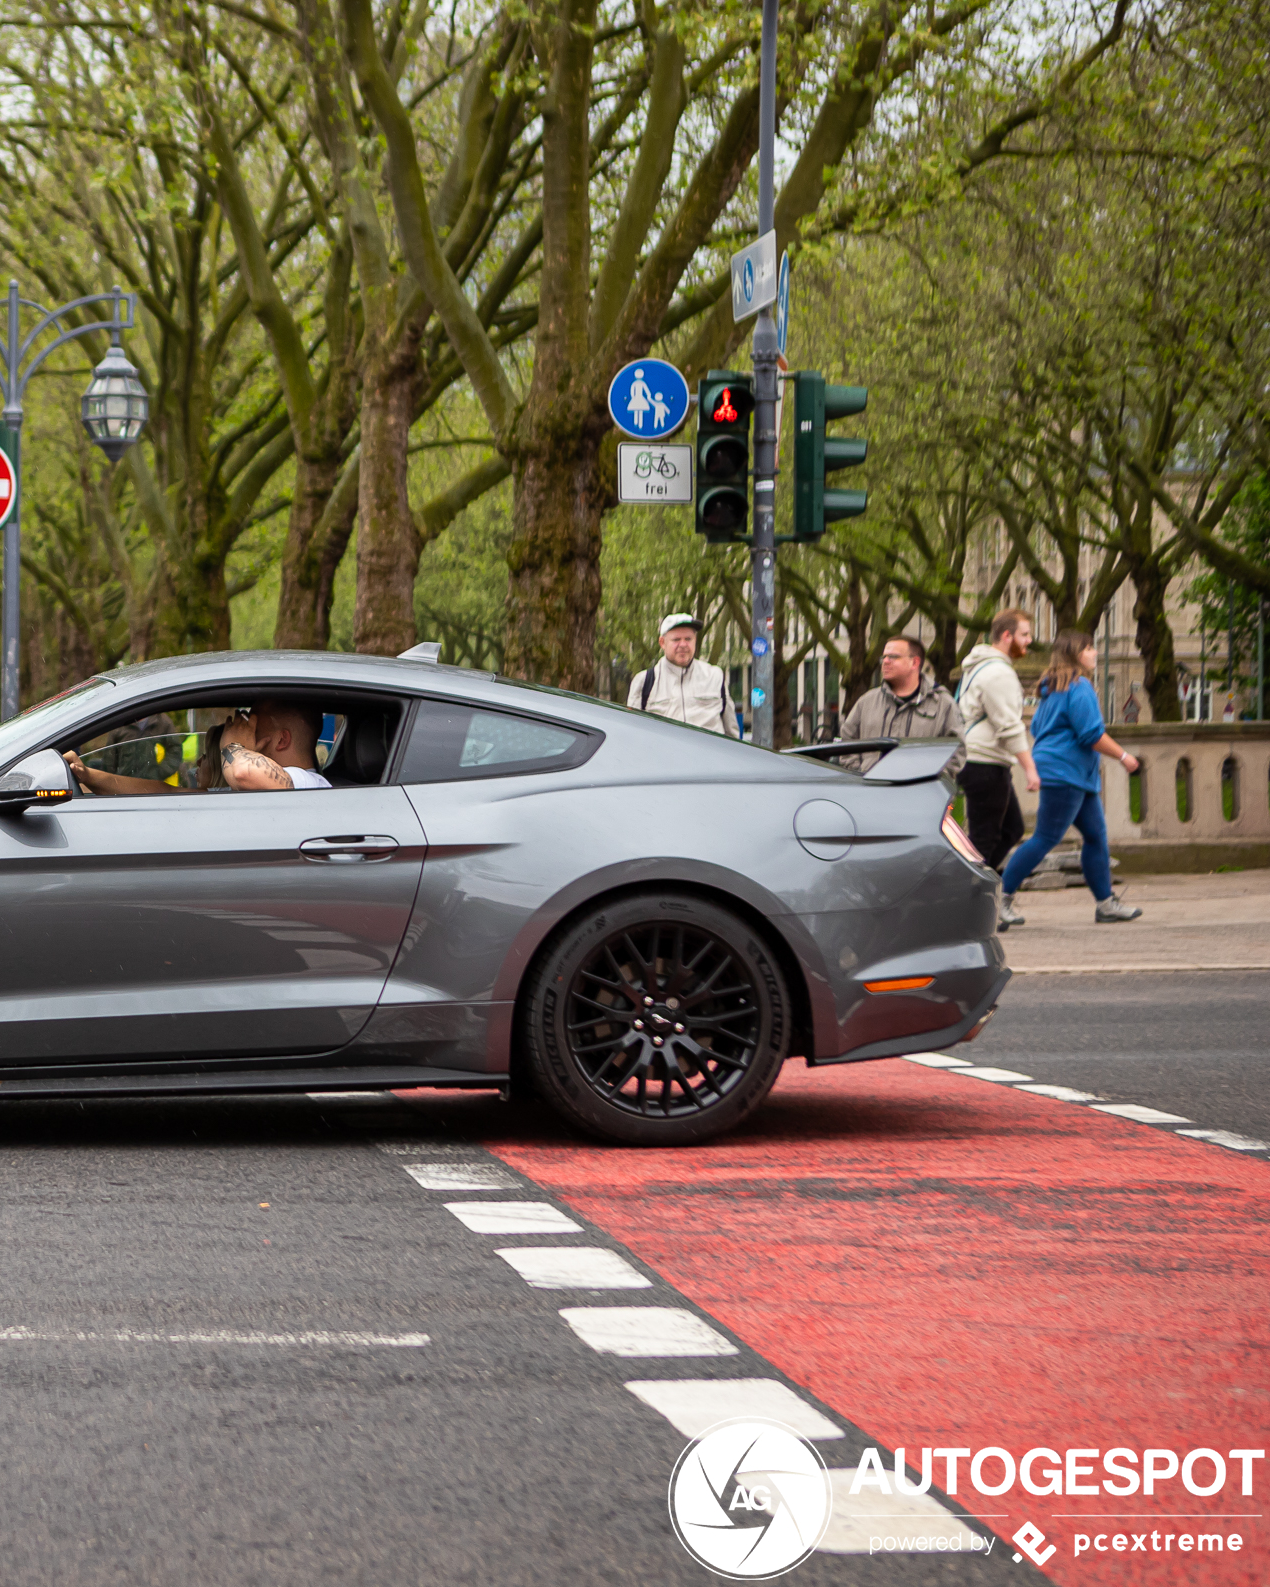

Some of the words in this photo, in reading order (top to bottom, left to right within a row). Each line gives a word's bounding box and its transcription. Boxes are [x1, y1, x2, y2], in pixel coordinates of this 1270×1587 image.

[645, 482, 668, 496] frei
[543, 992, 568, 1078] MICHELIN
[758, 962, 783, 1044] MICHELIN
